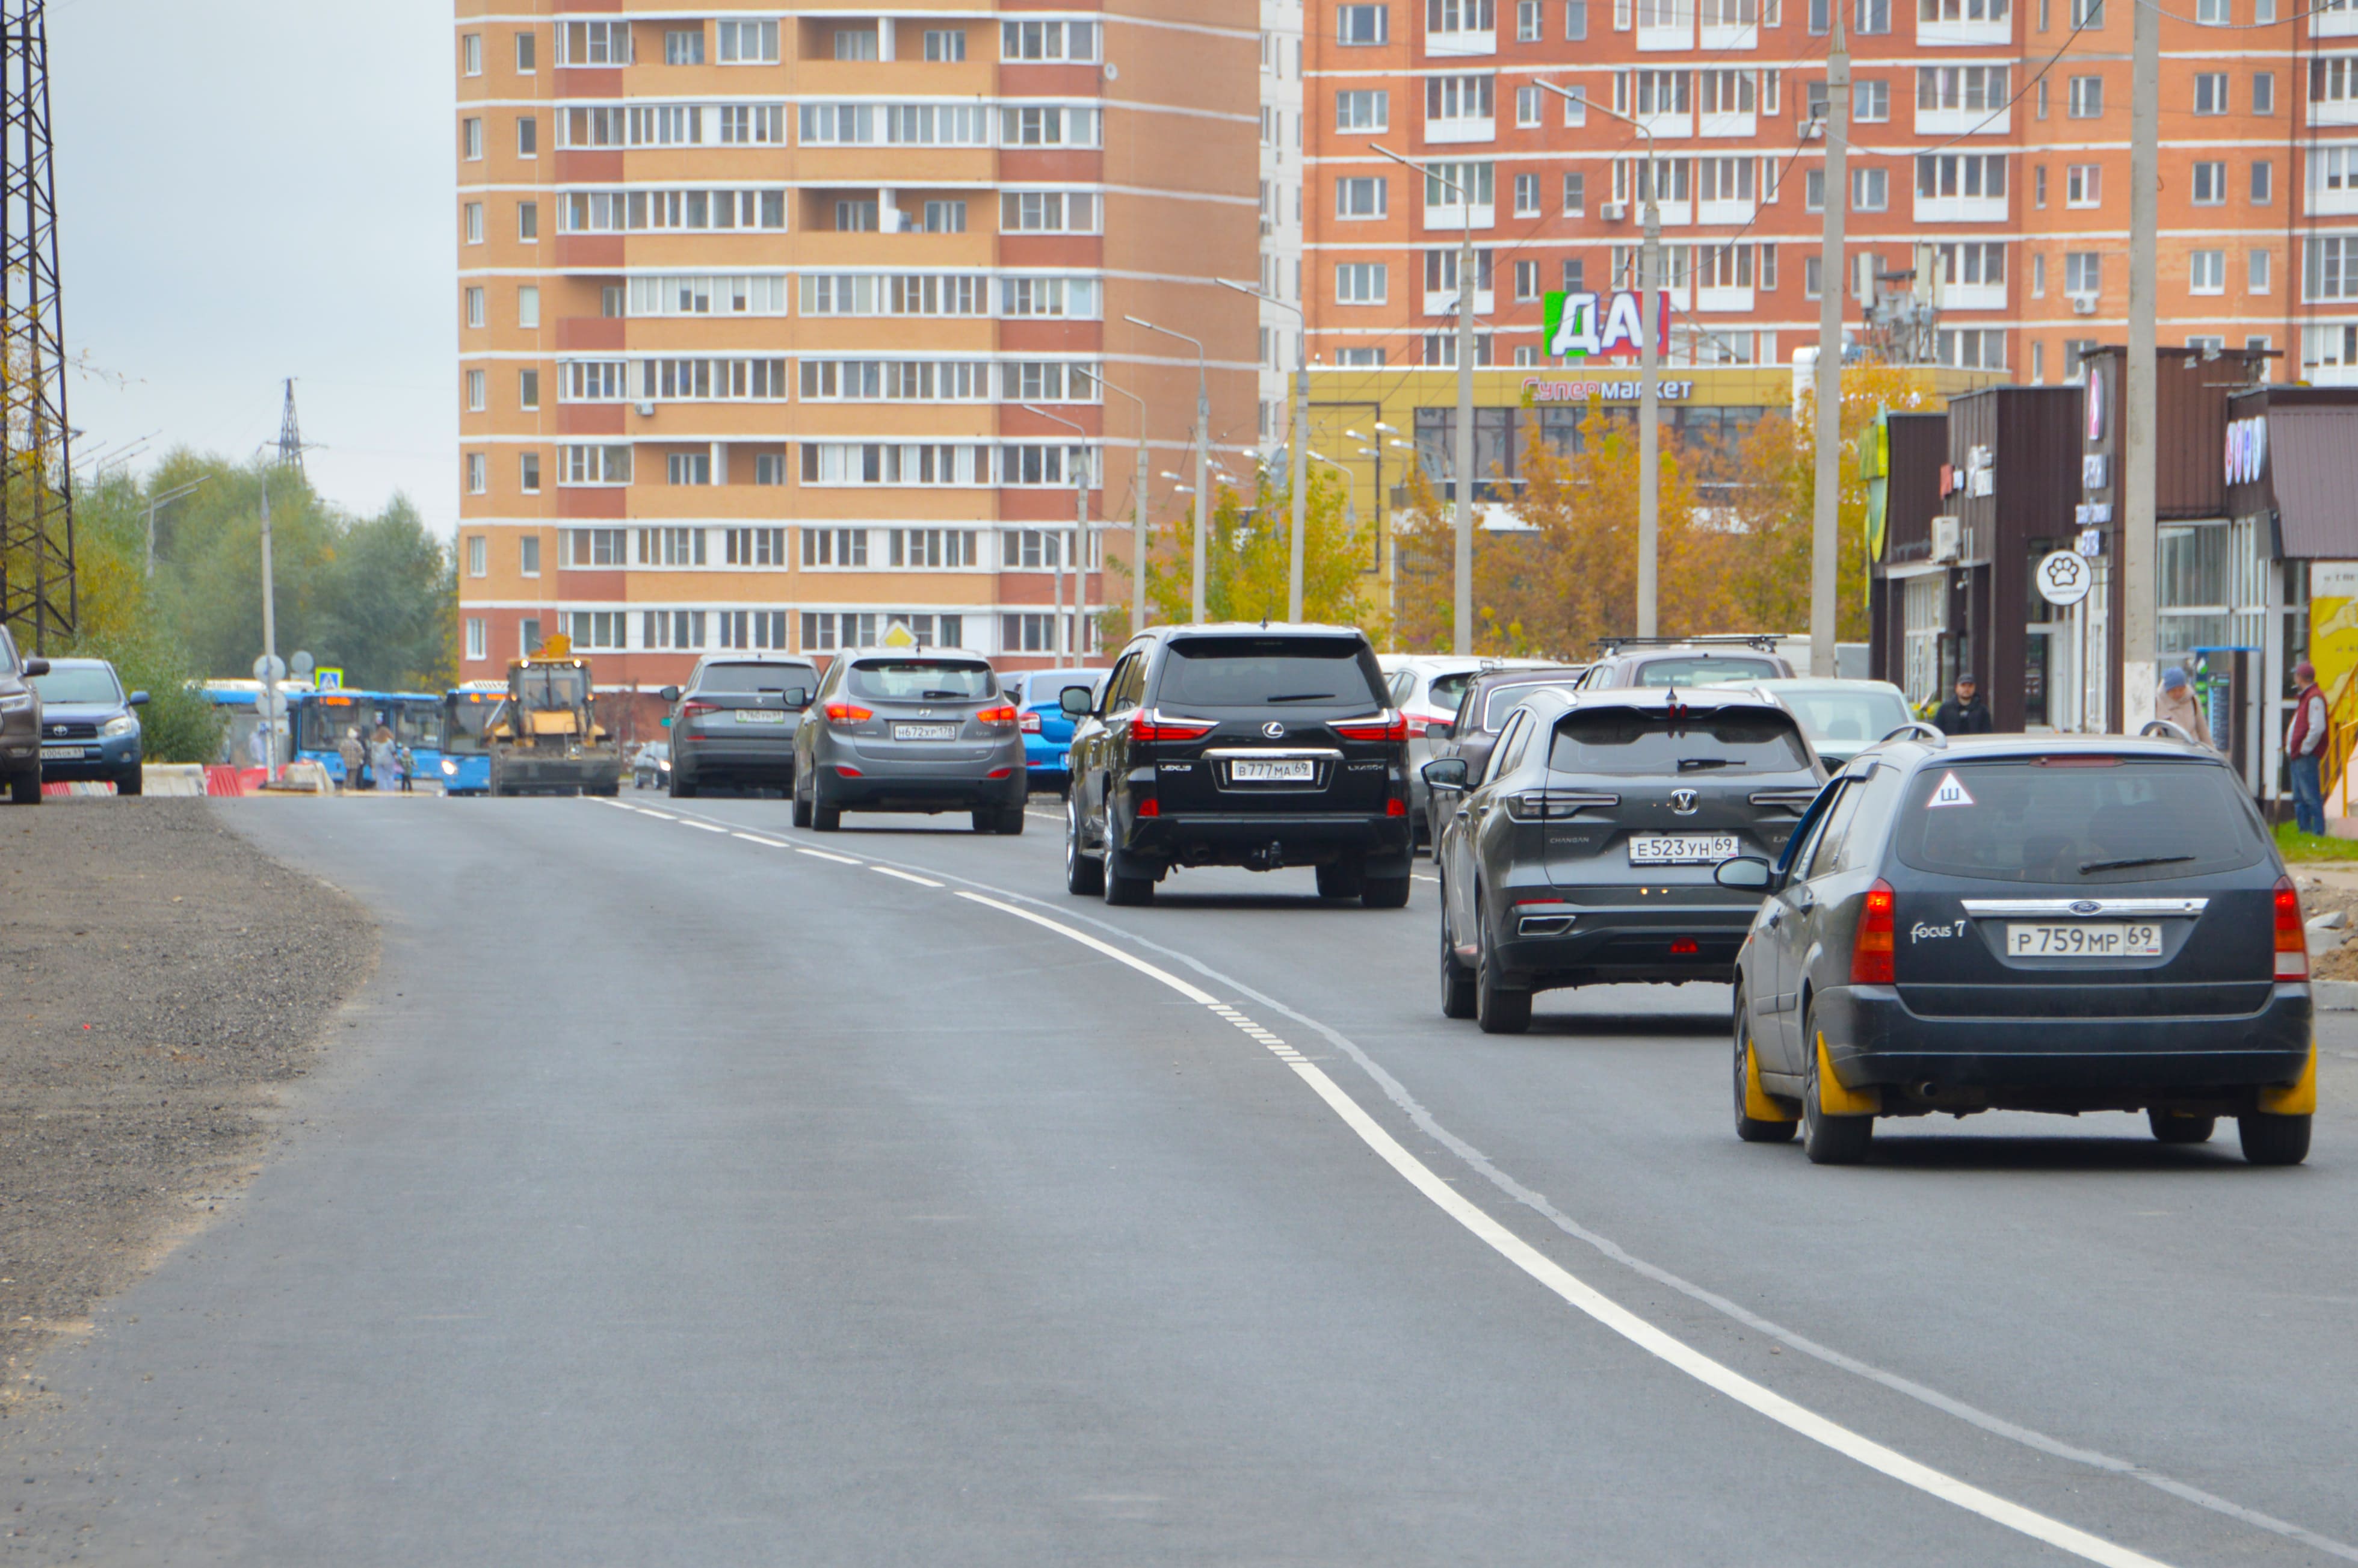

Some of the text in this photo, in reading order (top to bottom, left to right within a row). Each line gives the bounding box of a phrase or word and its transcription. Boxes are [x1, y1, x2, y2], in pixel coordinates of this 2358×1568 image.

[1940, 788, 1959, 801] Ш
[1638, 838, 1732, 856] Е523УН 69
[2018, 927, 2152, 952] Р759МР 69
